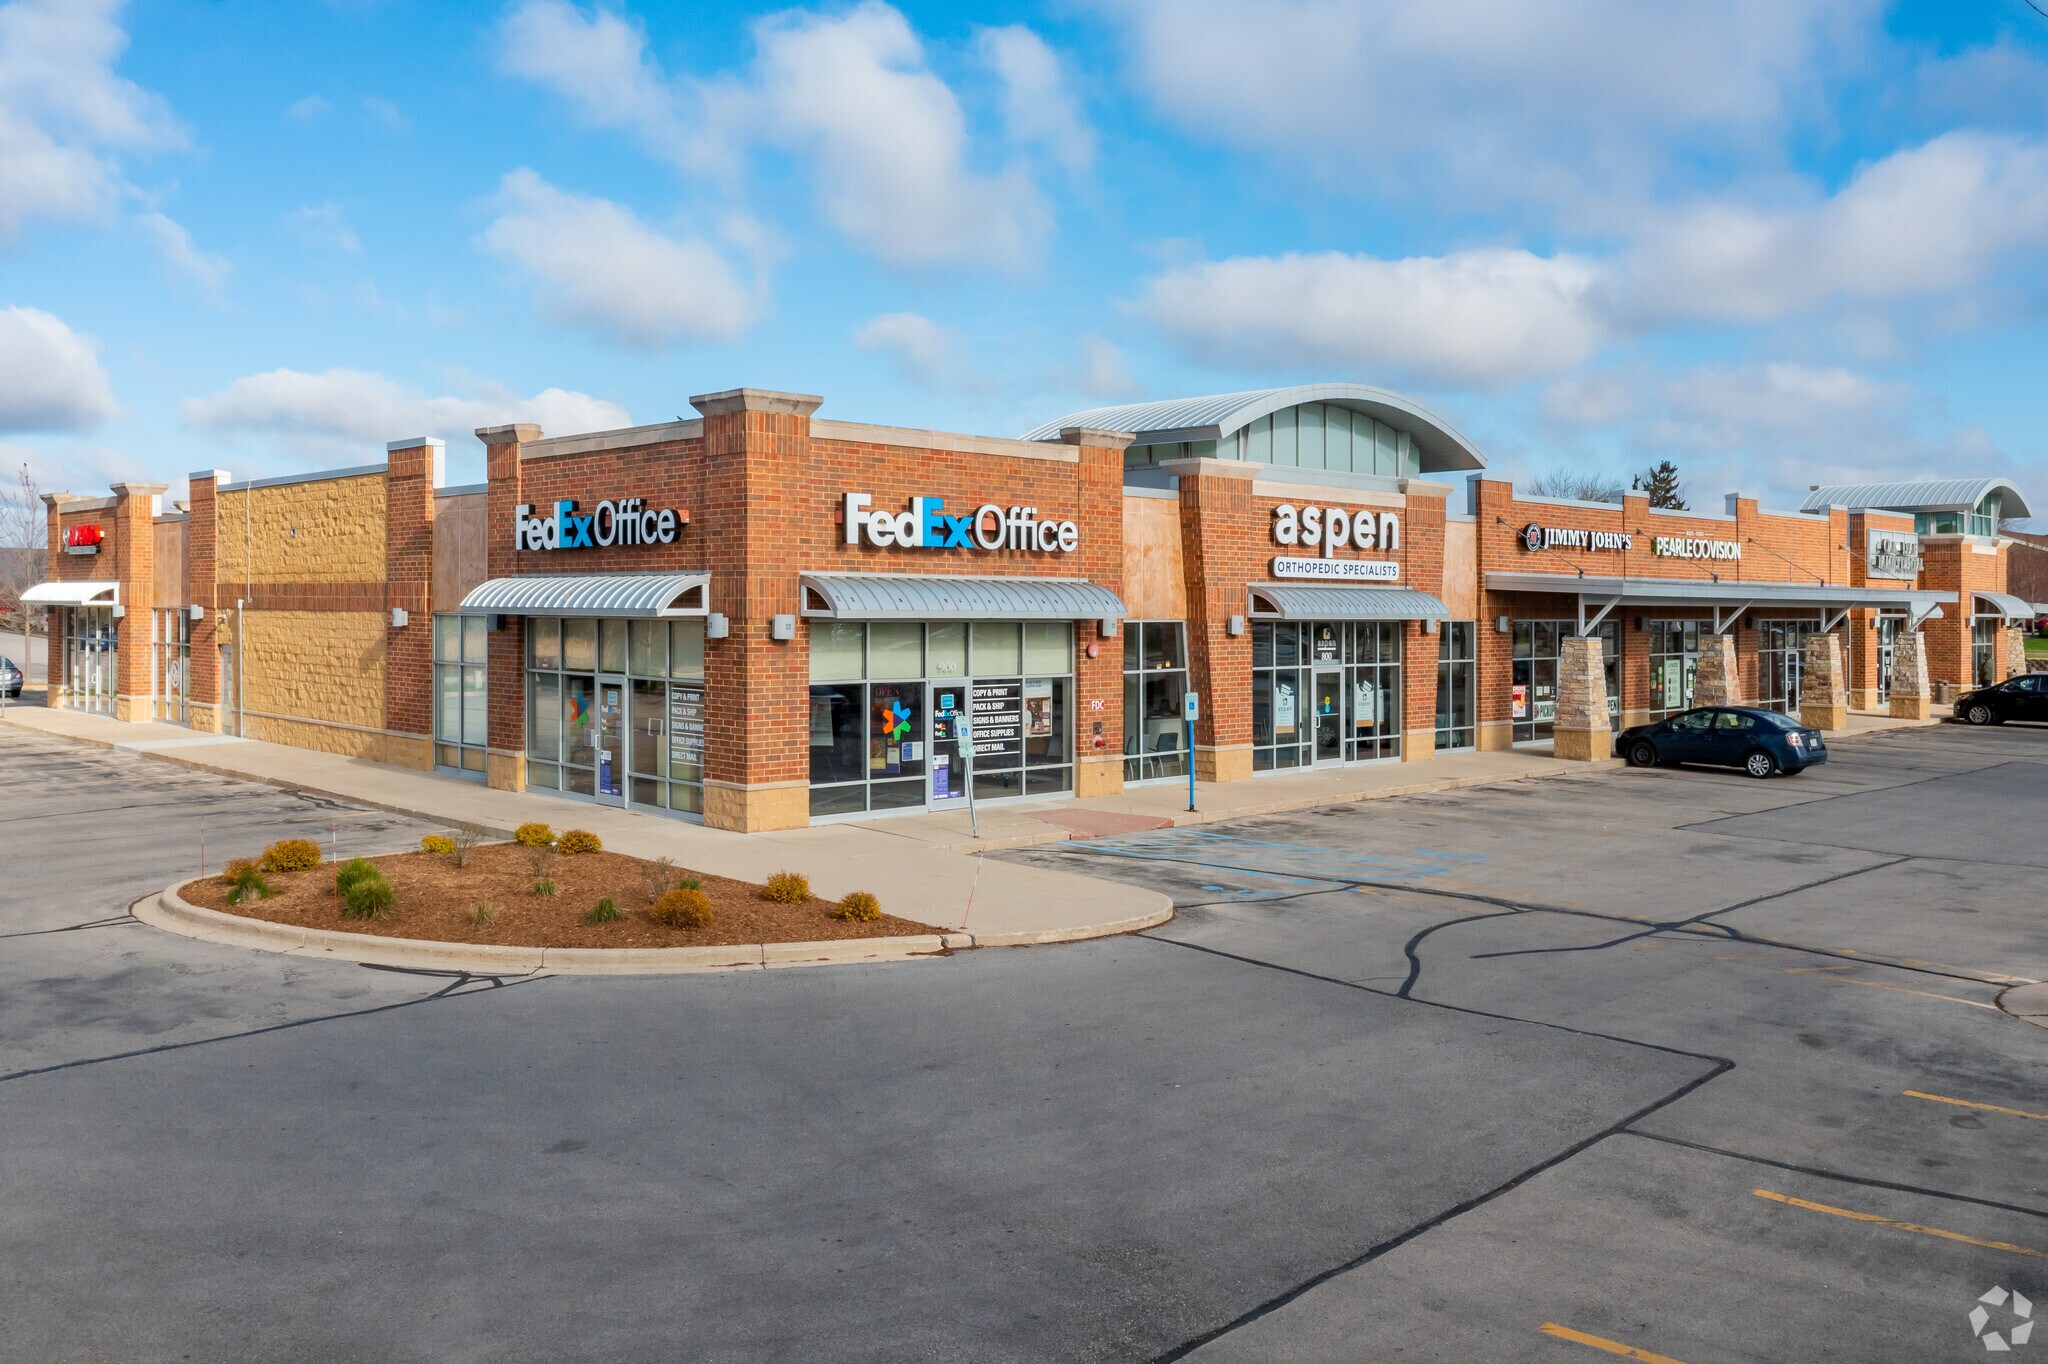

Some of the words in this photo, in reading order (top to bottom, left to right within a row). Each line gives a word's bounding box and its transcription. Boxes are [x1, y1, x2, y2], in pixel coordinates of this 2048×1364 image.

[516, 500, 593, 550] FedEx
[594, 498, 675, 547] Office
[846, 492, 974, 549] FedEx
[975, 504, 1079, 552] Office
[1275, 504, 1400, 559] aspen
[1544, 528, 1588, 549] JIMMY
[1590, 531, 1632, 552] JOHN'S
[1277, 561, 1340, 574] ORTHOPEDIC
[1343, 564, 1397, 577] SPECIALISTS
[1321, 652, 1332, 661] 800
[939, 661, 957, 672] 900
[671, 692, 683, 700] COPY
[683, 693, 687, 701] &
[973, 689, 987, 697] COPY
[987, 689, 991, 697] &
[993, 688, 1008, 696] PRINT
[973, 703, 987, 711] PACK
[987, 702, 991, 710] &
[992, 702, 1004, 710] SHIP
[1091, 700, 1104, 710] FDC
[1608, 700, 1617, 712] PEN
[671, 707, 683, 715] PACK
[687, 708, 697, 716] SHIP
[973, 716, 989, 725] SIGNS
[990, 716, 994, 724] &
[995, 715, 1020, 723] BANNERS
[671, 721, 684, 730] SIGNS
[685, 722, 688, 730] &
[973, 730, 990, 738] OFFICE
[991, 729, 1014, 737] SUPPLIES
[671, 736, 685, 744] OFFICE
[973, 744, 991, 752] DIRECT
[992, 743, 1005, 751] MAIL
[671, 751, 686, 759] DIRECT
[687, 753, 697, 761] MAIL
